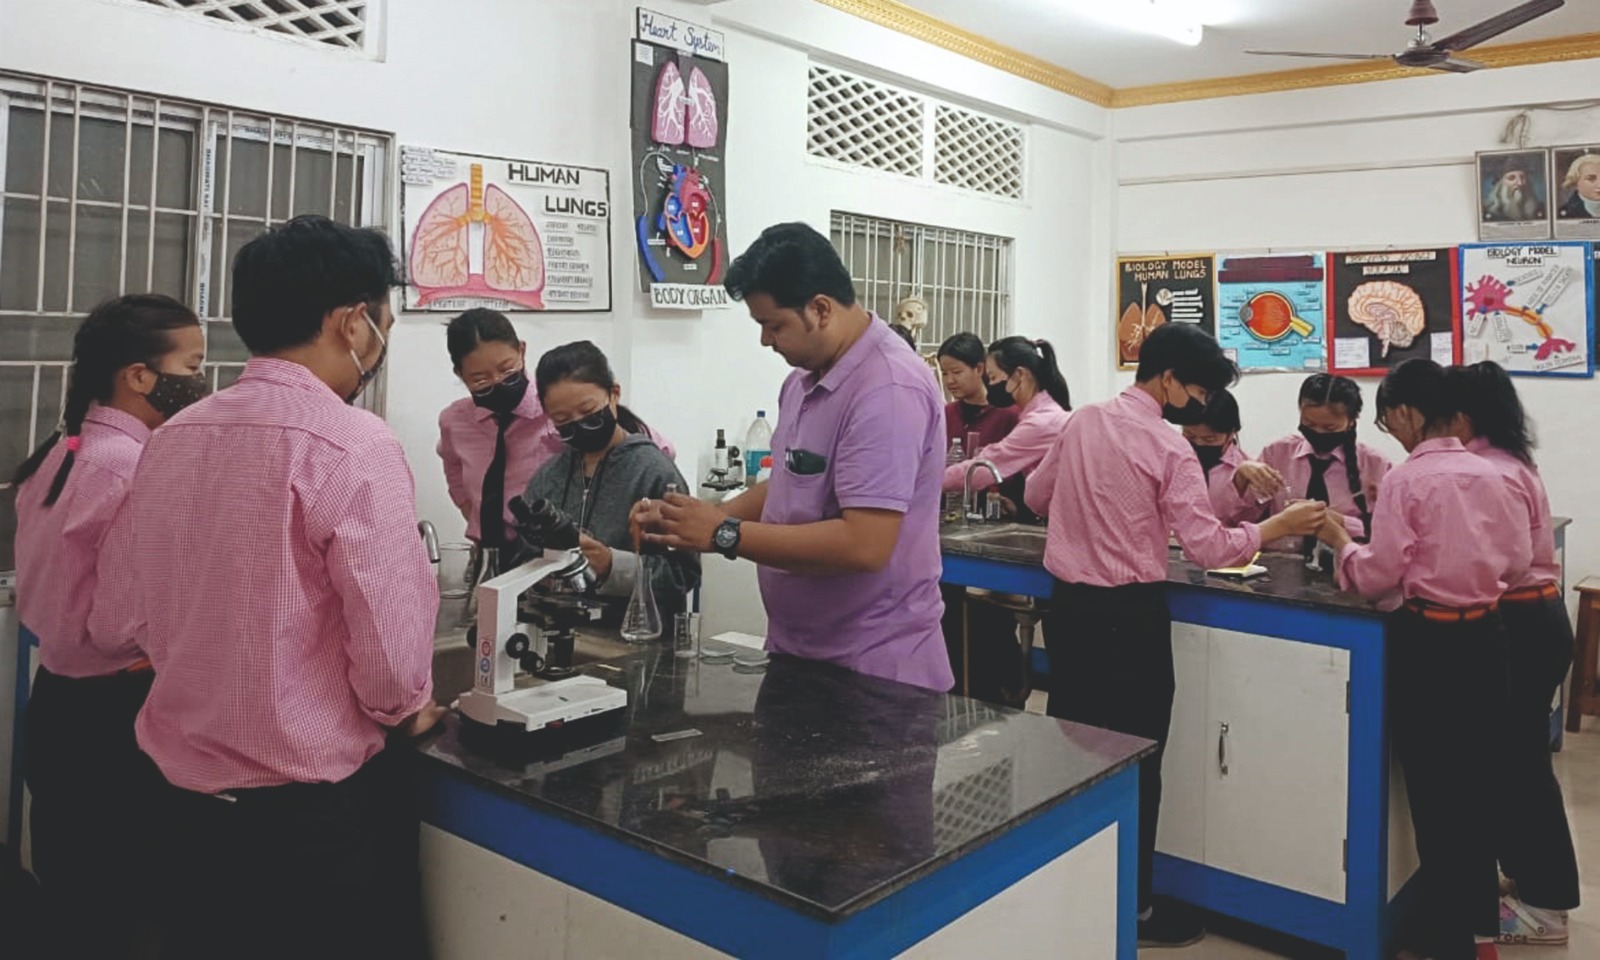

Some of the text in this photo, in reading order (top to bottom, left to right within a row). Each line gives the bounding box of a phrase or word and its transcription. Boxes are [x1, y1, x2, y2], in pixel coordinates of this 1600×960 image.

[641, 13, 677, 41] Heart
[684, 27, 720, 55] System
[508, 163, 580, 185] HUMAN
[545, 195, 607, 217] LUNGS
[1487, 246, 1555, 257] BIOLOGY MODEL
[1125, 260, 1206, 272] BIOLOGY MODEL
[1506, 256, 1541, 265] NEURON
[1134, 269, 1206, 281] HUMAN LUNGS
[654, 287, 728, 305] BODY ORGAN
